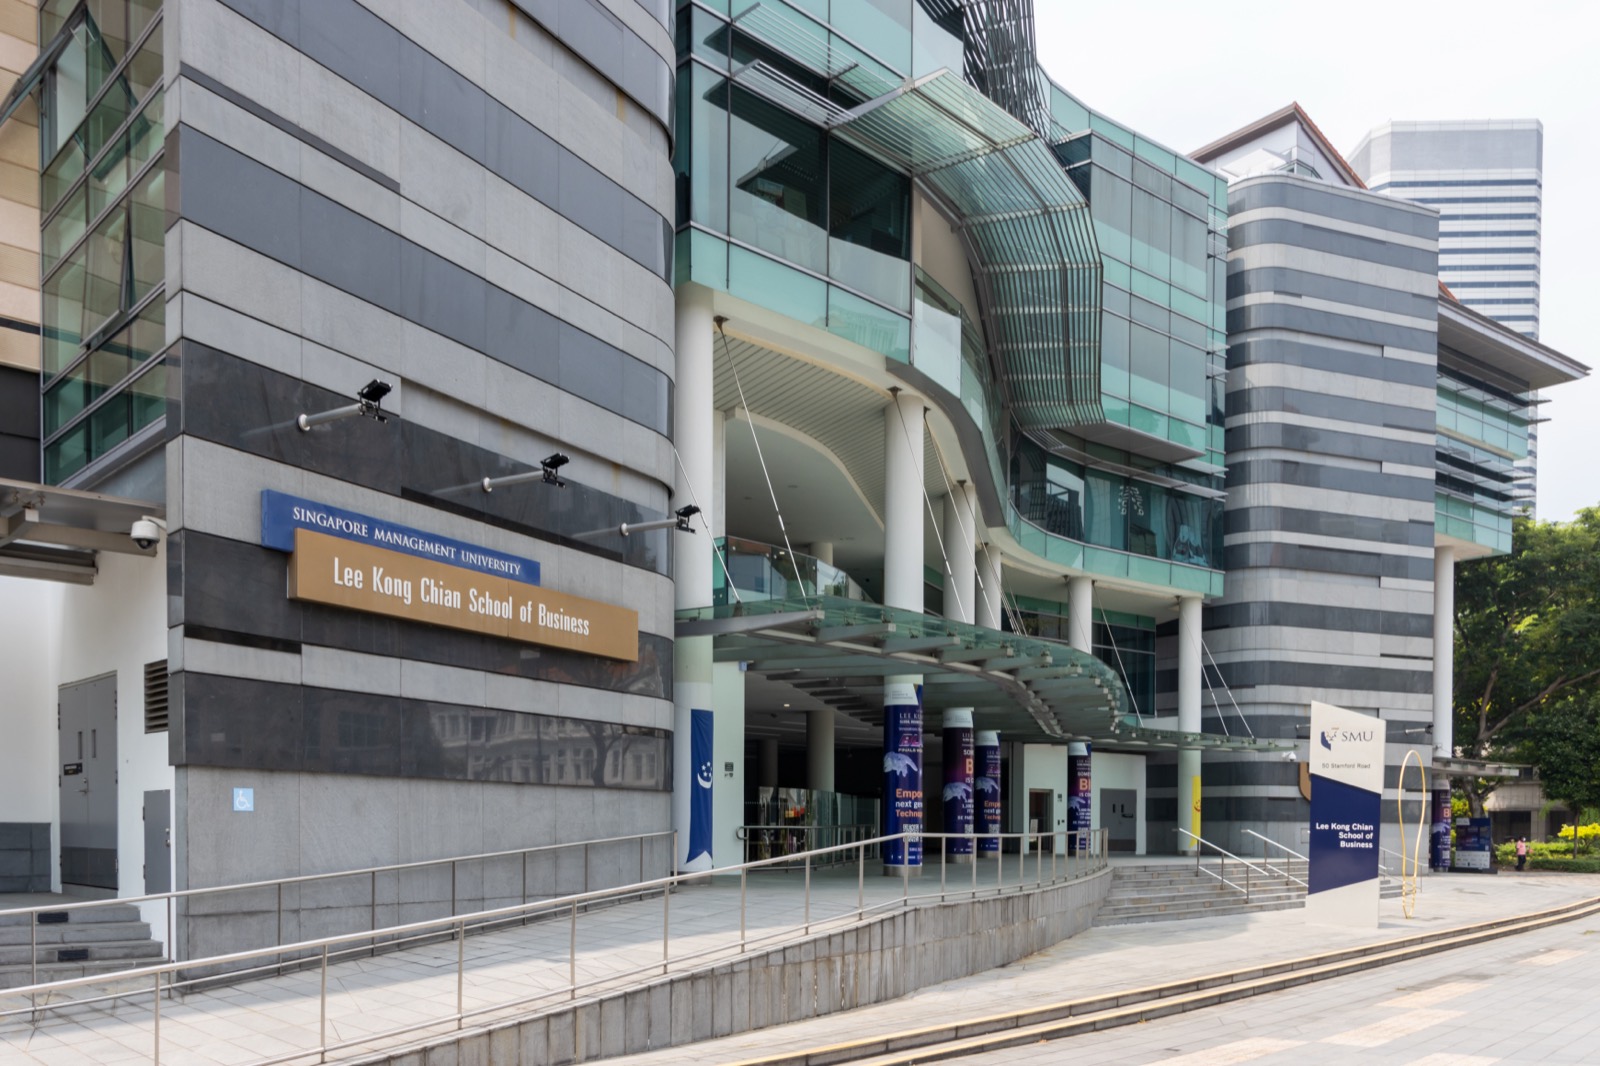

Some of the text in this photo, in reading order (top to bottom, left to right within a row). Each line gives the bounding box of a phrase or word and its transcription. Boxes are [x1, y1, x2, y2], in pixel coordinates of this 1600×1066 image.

[293, 506, 521, 575] SINGAPORE MANAGEMENT UNIVERSITY
[334, 556, 590, 636] Lee Kong Chian School of Business
[1341, 730, 1373, 742] SMU
[895, 800, 912, 808] next
[1315, 822, 1374, 832] Lee Kong Chian
[1338, 831, 1374, 840] School of
[1339, 841, 1373, 849] Business
